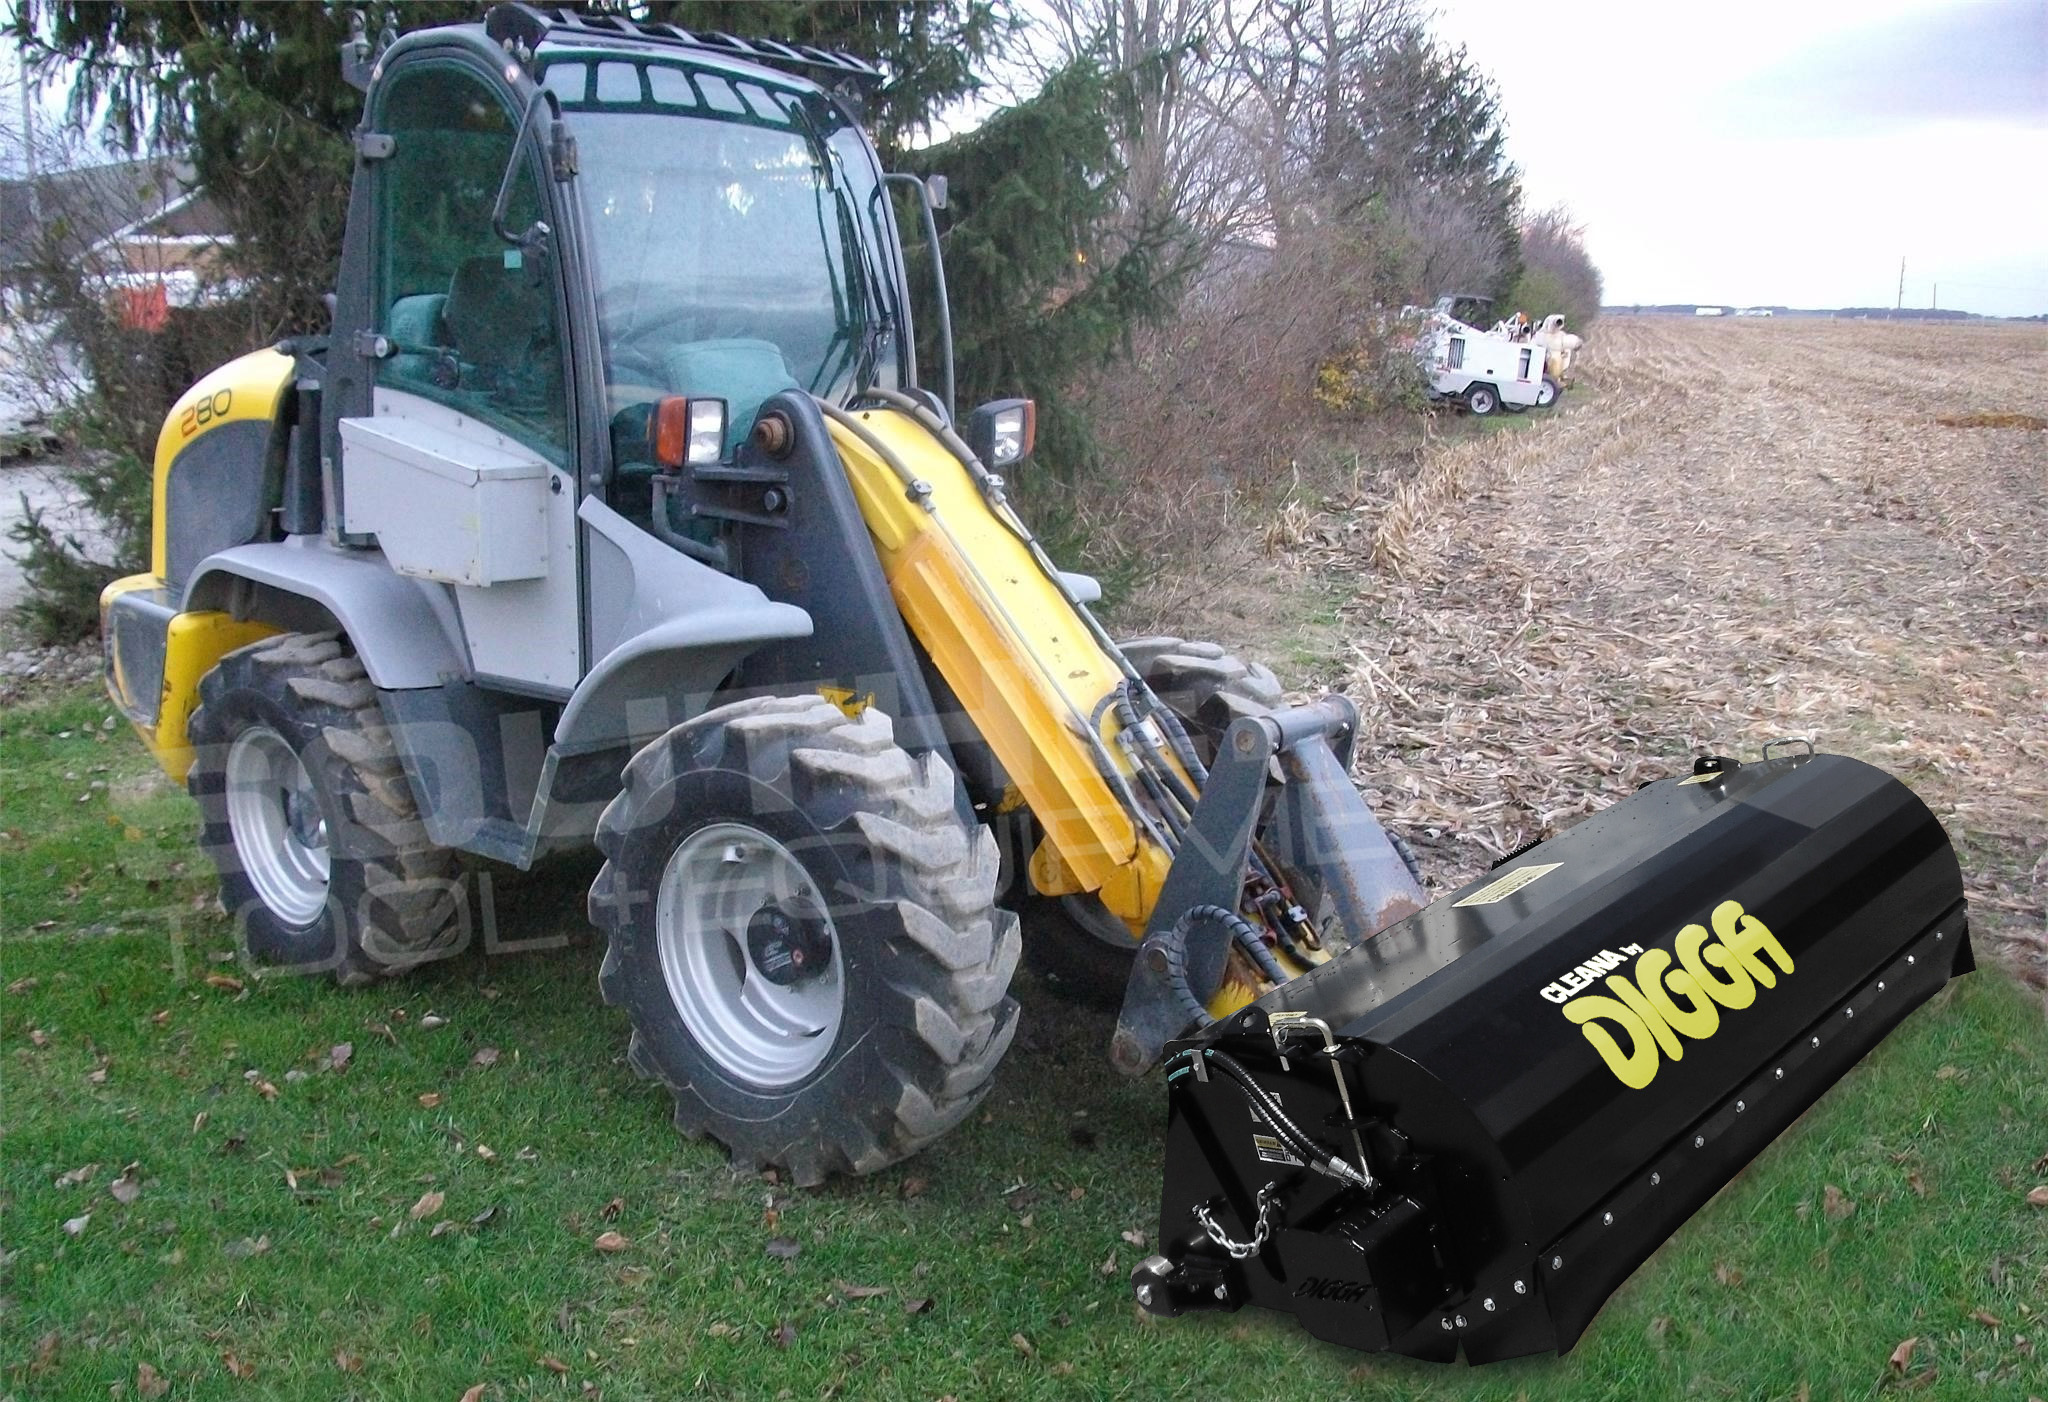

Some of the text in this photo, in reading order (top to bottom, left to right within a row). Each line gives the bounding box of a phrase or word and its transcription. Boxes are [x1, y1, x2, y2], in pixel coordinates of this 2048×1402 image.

[181, 388, 232, 438] 280
[1539, 942, 1645, 1004] CLEANA by
[1562, 899, 1795, 1090] DIGGA
[1291, 1276, 1373, 1304] DIGGA
